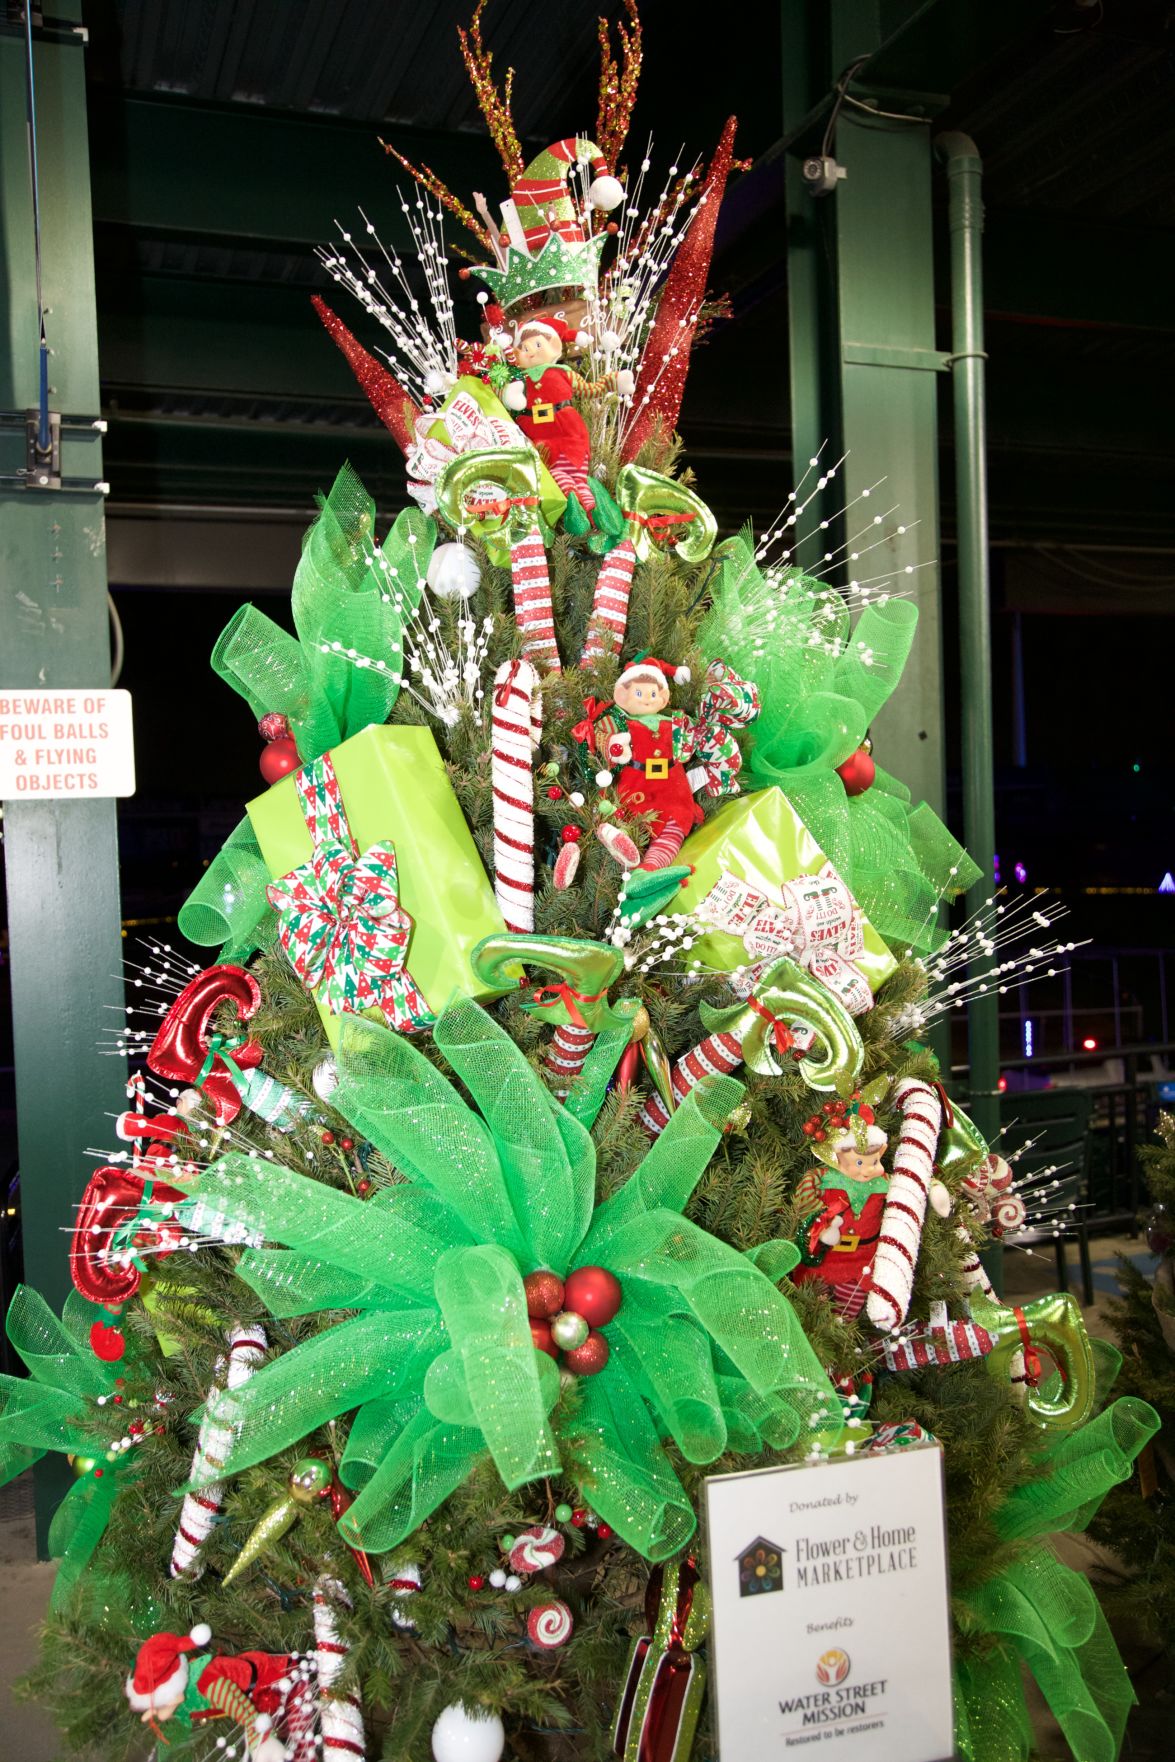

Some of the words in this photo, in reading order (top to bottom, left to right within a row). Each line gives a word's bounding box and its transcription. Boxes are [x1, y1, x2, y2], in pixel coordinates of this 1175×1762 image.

[452, 400, 479, 426] ELVES
[0, 698, 77, 714] BEWARE
[83, 697, 106, 714] OF
[0, 723, 47, 740] FOUL
[54, 722, 109, 739] BALLS
[15, 749, 27, 766] &
[35, 748, 97, 765] FLYING
[16, 773, 98, 791] OBJECTS
[810, 921, 846, 942] ELVES
[789, 1494, 842, 1512] Donated
[845, 1492, 858, 1506] by
[795, 1538, 850, 1562] Flower
[853, 1530, 868, 1551] &
[870, 1525, 916, 1550] Home
[797, 1547, 917, 1588] MARKETPLACE
[806, 1617, 854, 1634] Benefits
[779, 1692, 831, 1714] WATER
[835, 1680, 888, 1703] STREET
[802, 1701, 866, 1726] MISSION
[785, 1731, 822, 1747] Restored
[823, 1729, 833, 1739] to
[835, 1727, 845, 1737] be
[847, 1719, 885, 1735] restorers
